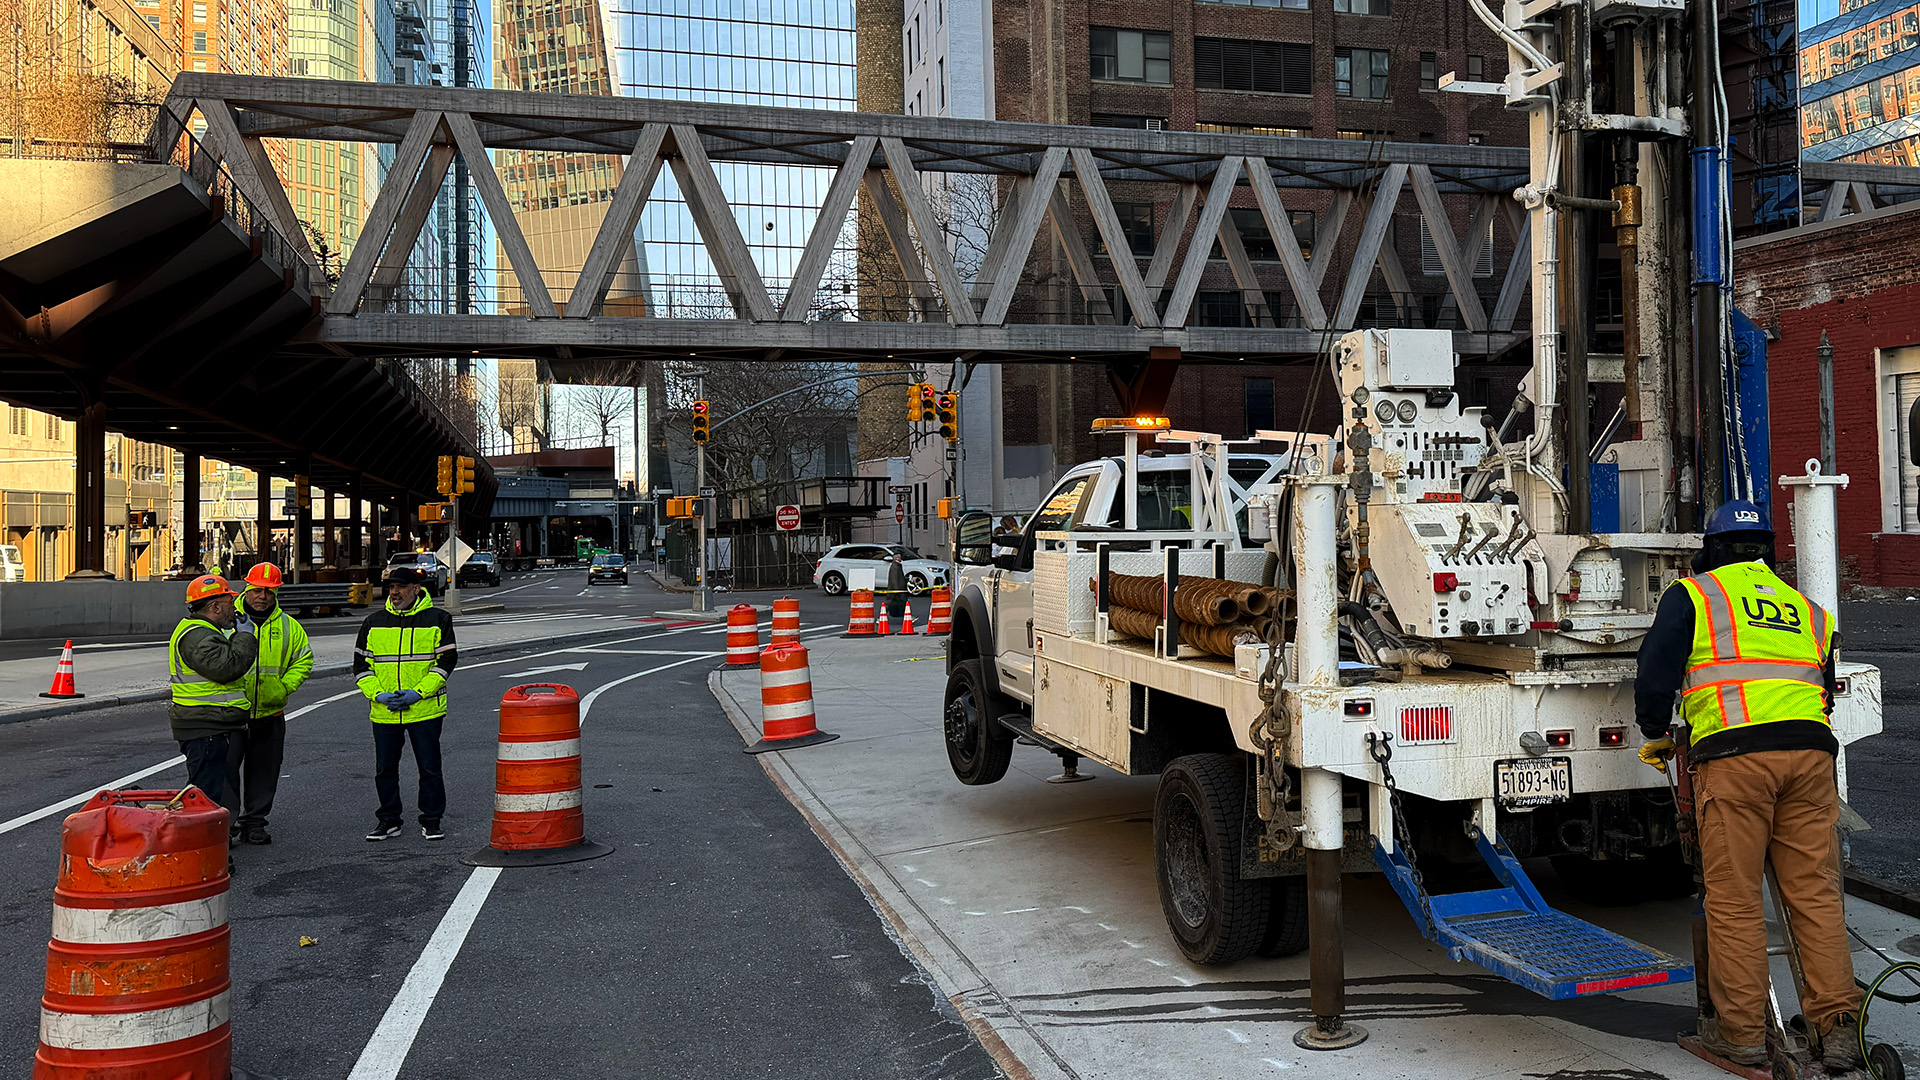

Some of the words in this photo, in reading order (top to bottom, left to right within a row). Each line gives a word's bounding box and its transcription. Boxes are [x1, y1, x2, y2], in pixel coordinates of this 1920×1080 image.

[1514, 763, 1530, 771] NEW
[1532, 762, 1552, 770] YORK
[1515, 798, 1552, 806] EMPIRE
